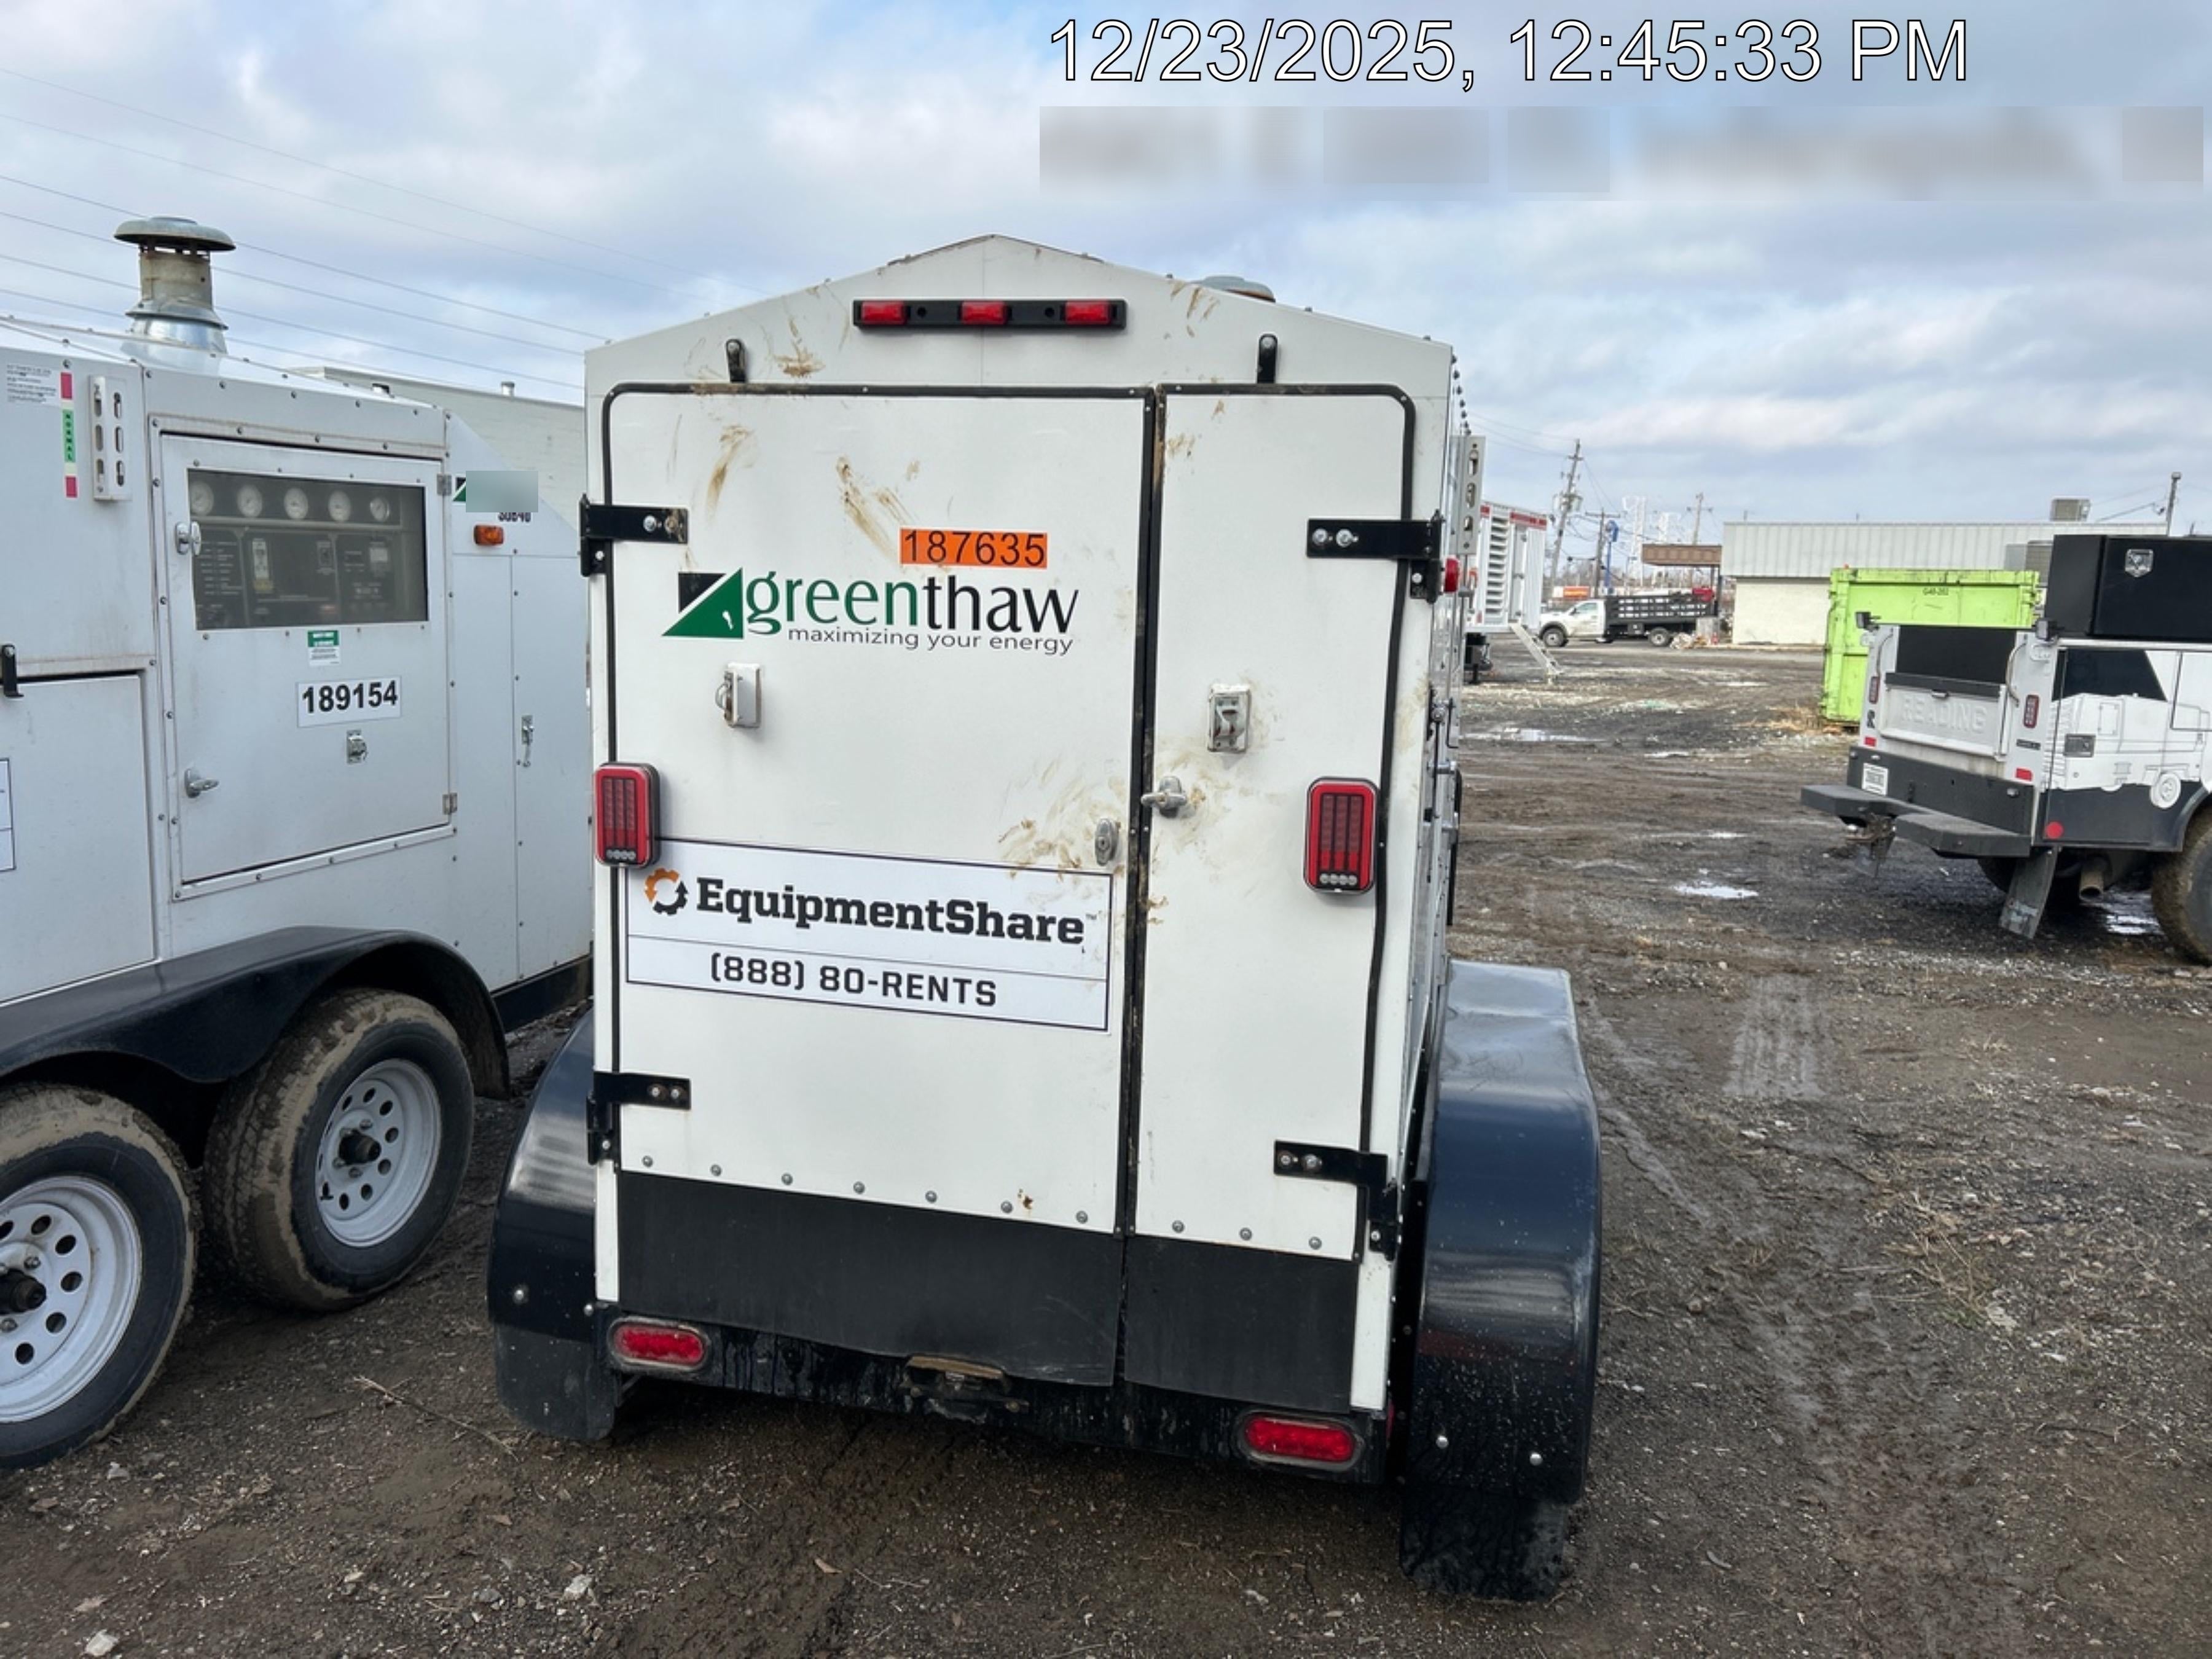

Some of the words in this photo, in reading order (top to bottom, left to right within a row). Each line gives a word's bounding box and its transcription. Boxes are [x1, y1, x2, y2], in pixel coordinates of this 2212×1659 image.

[904, 531, 1045, 565] 187635
[745, 570, 1080, 635] greenthaw
[788, 627, 919, 649] maximizing
[927, 635, 981, 651] your
[989, 637, 1073, 656] energy
[302, 680, 398, 714] 189154
[1902, 696, 1988, 734] READING
[697, 877, 1084, 945] EquipmentShare
[711, 952, 804, 990] (888)
[819, 965, 997, 1007] 80-RENTS
